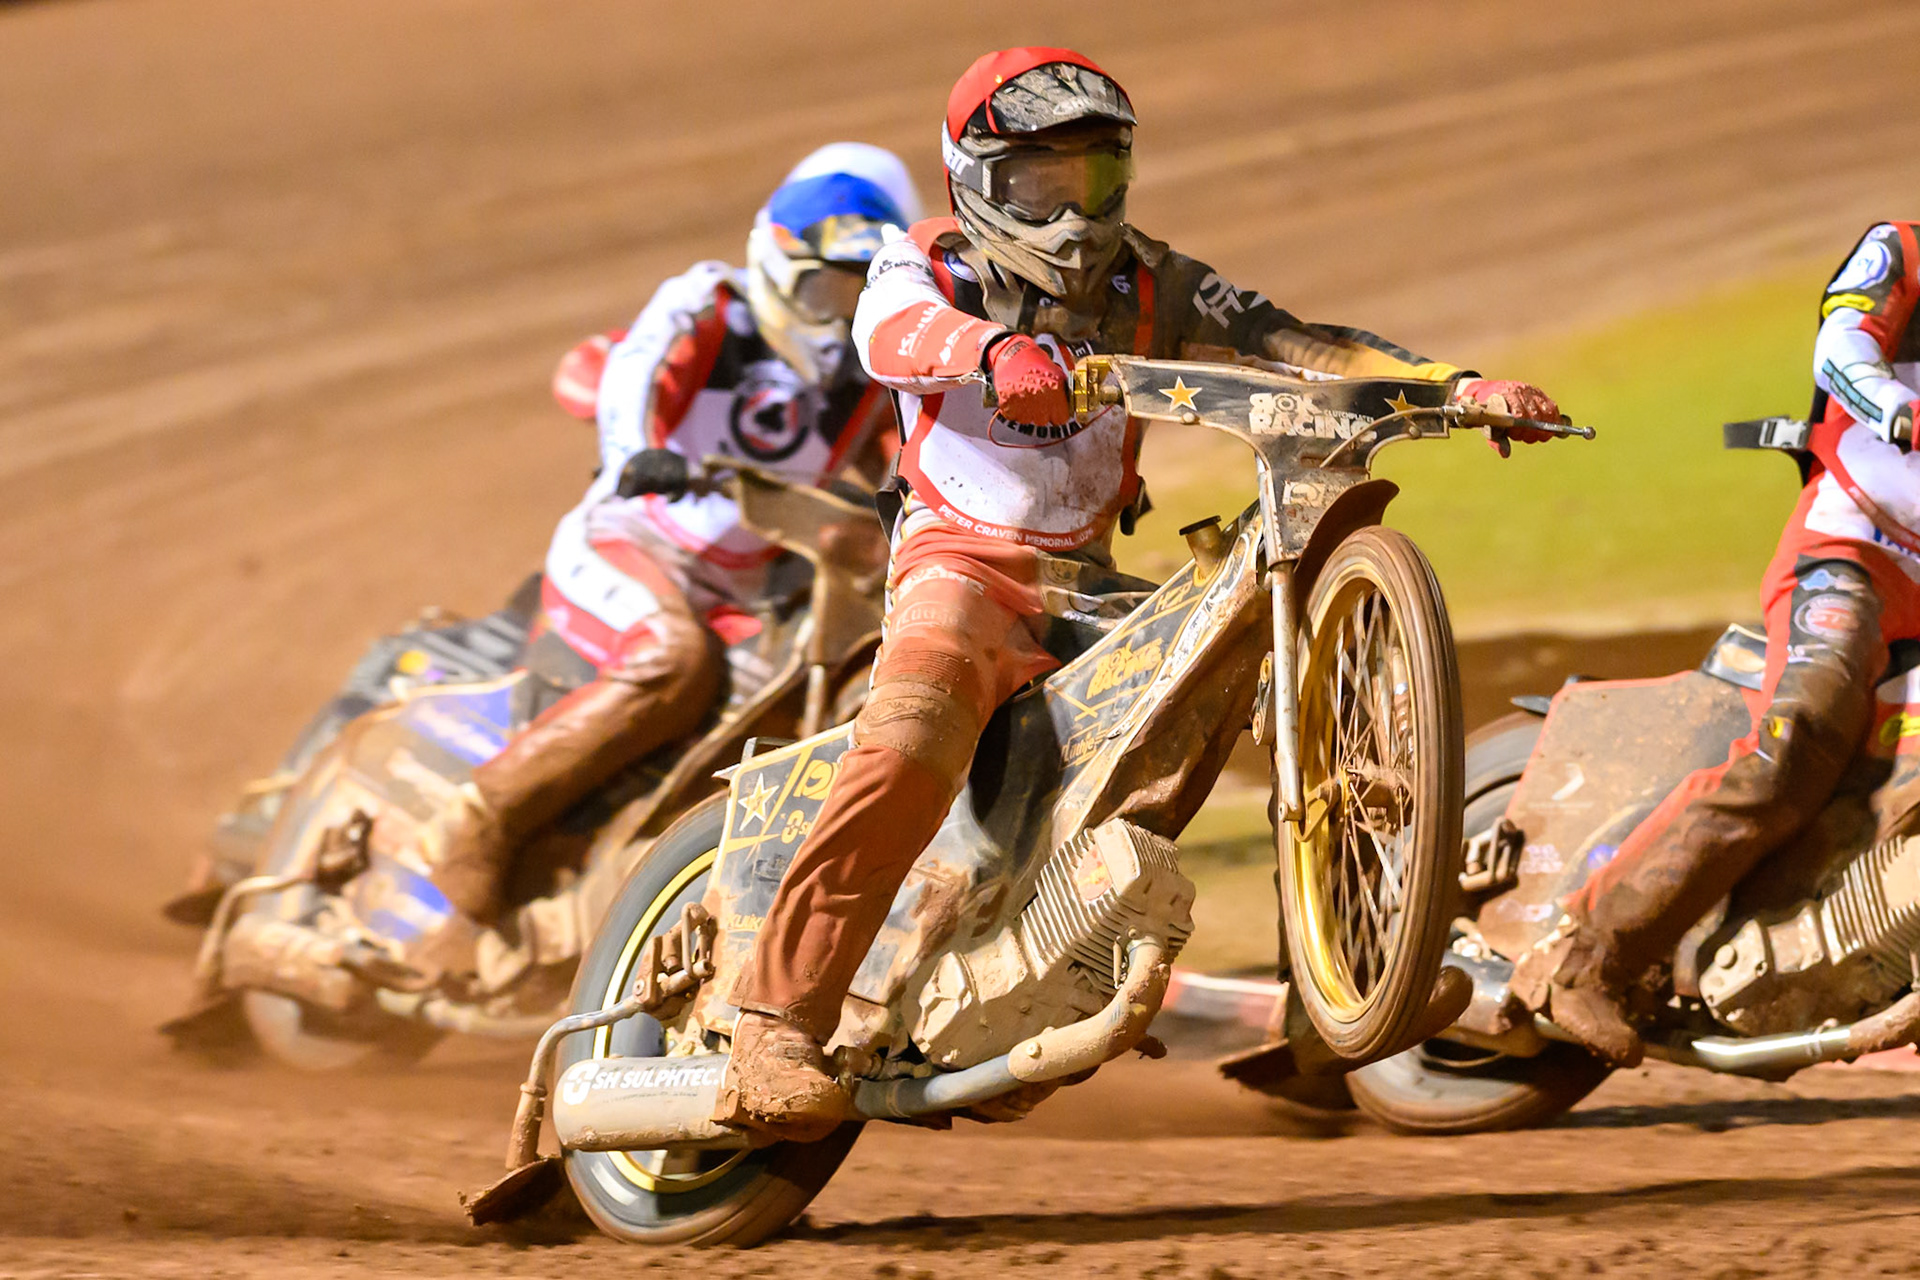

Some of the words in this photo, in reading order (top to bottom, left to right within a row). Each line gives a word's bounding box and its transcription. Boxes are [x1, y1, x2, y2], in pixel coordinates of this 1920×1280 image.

[1249, 411, 1378, 442] RACING
[937, 504, 974, 529] PETER
[974, 524, 1023, 542] CRAVEN
[1025, 533, 1076, 548] MEMORIAL
[592, 1071, 620, 1090] SH
[620, 1067, 719, 1089] SULPHTEC.
